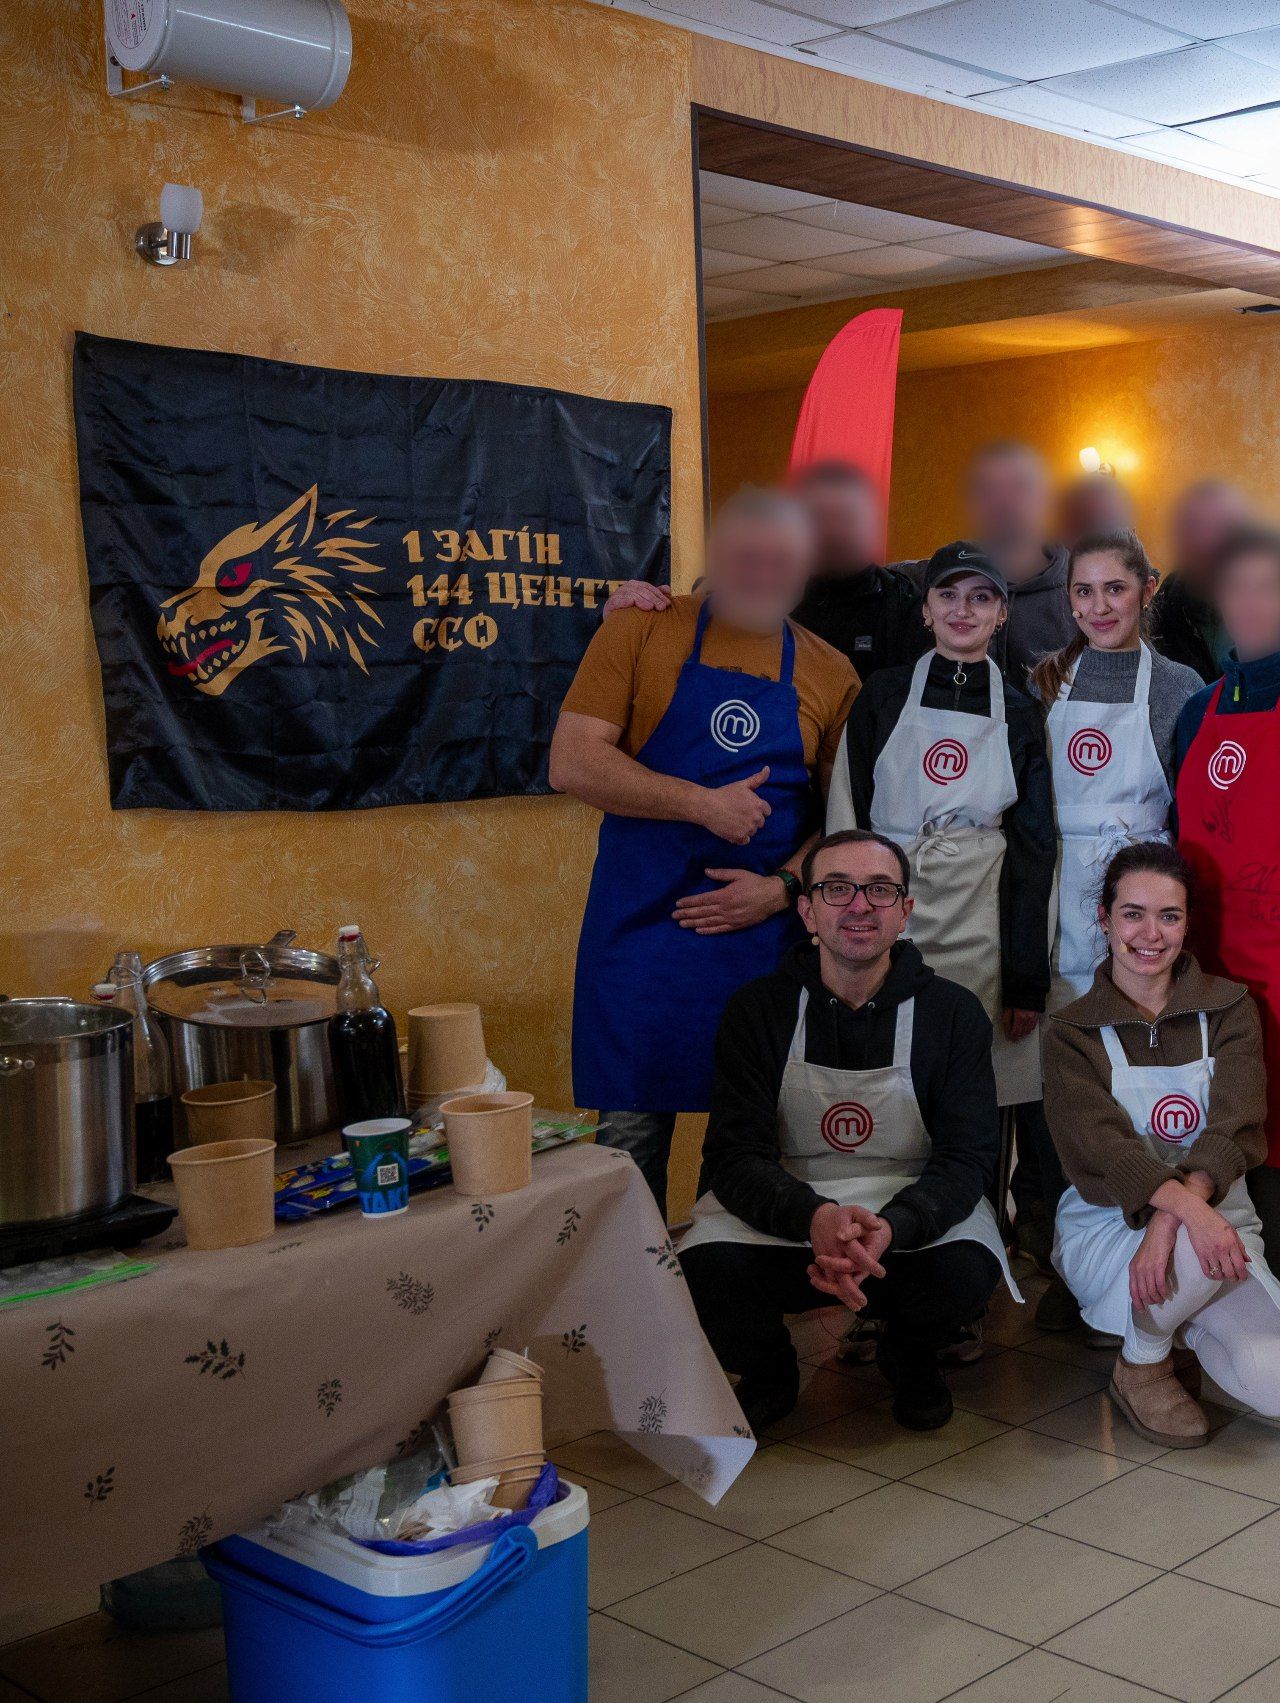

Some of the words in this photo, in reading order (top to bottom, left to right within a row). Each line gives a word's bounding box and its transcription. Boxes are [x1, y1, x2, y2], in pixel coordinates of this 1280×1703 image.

[402, 530, 425, 563] 1
[432, 525, 563, 565] ЗАГІН
[406, 573, 474, 607] 144
[412, 612, 498, 653] ССО
